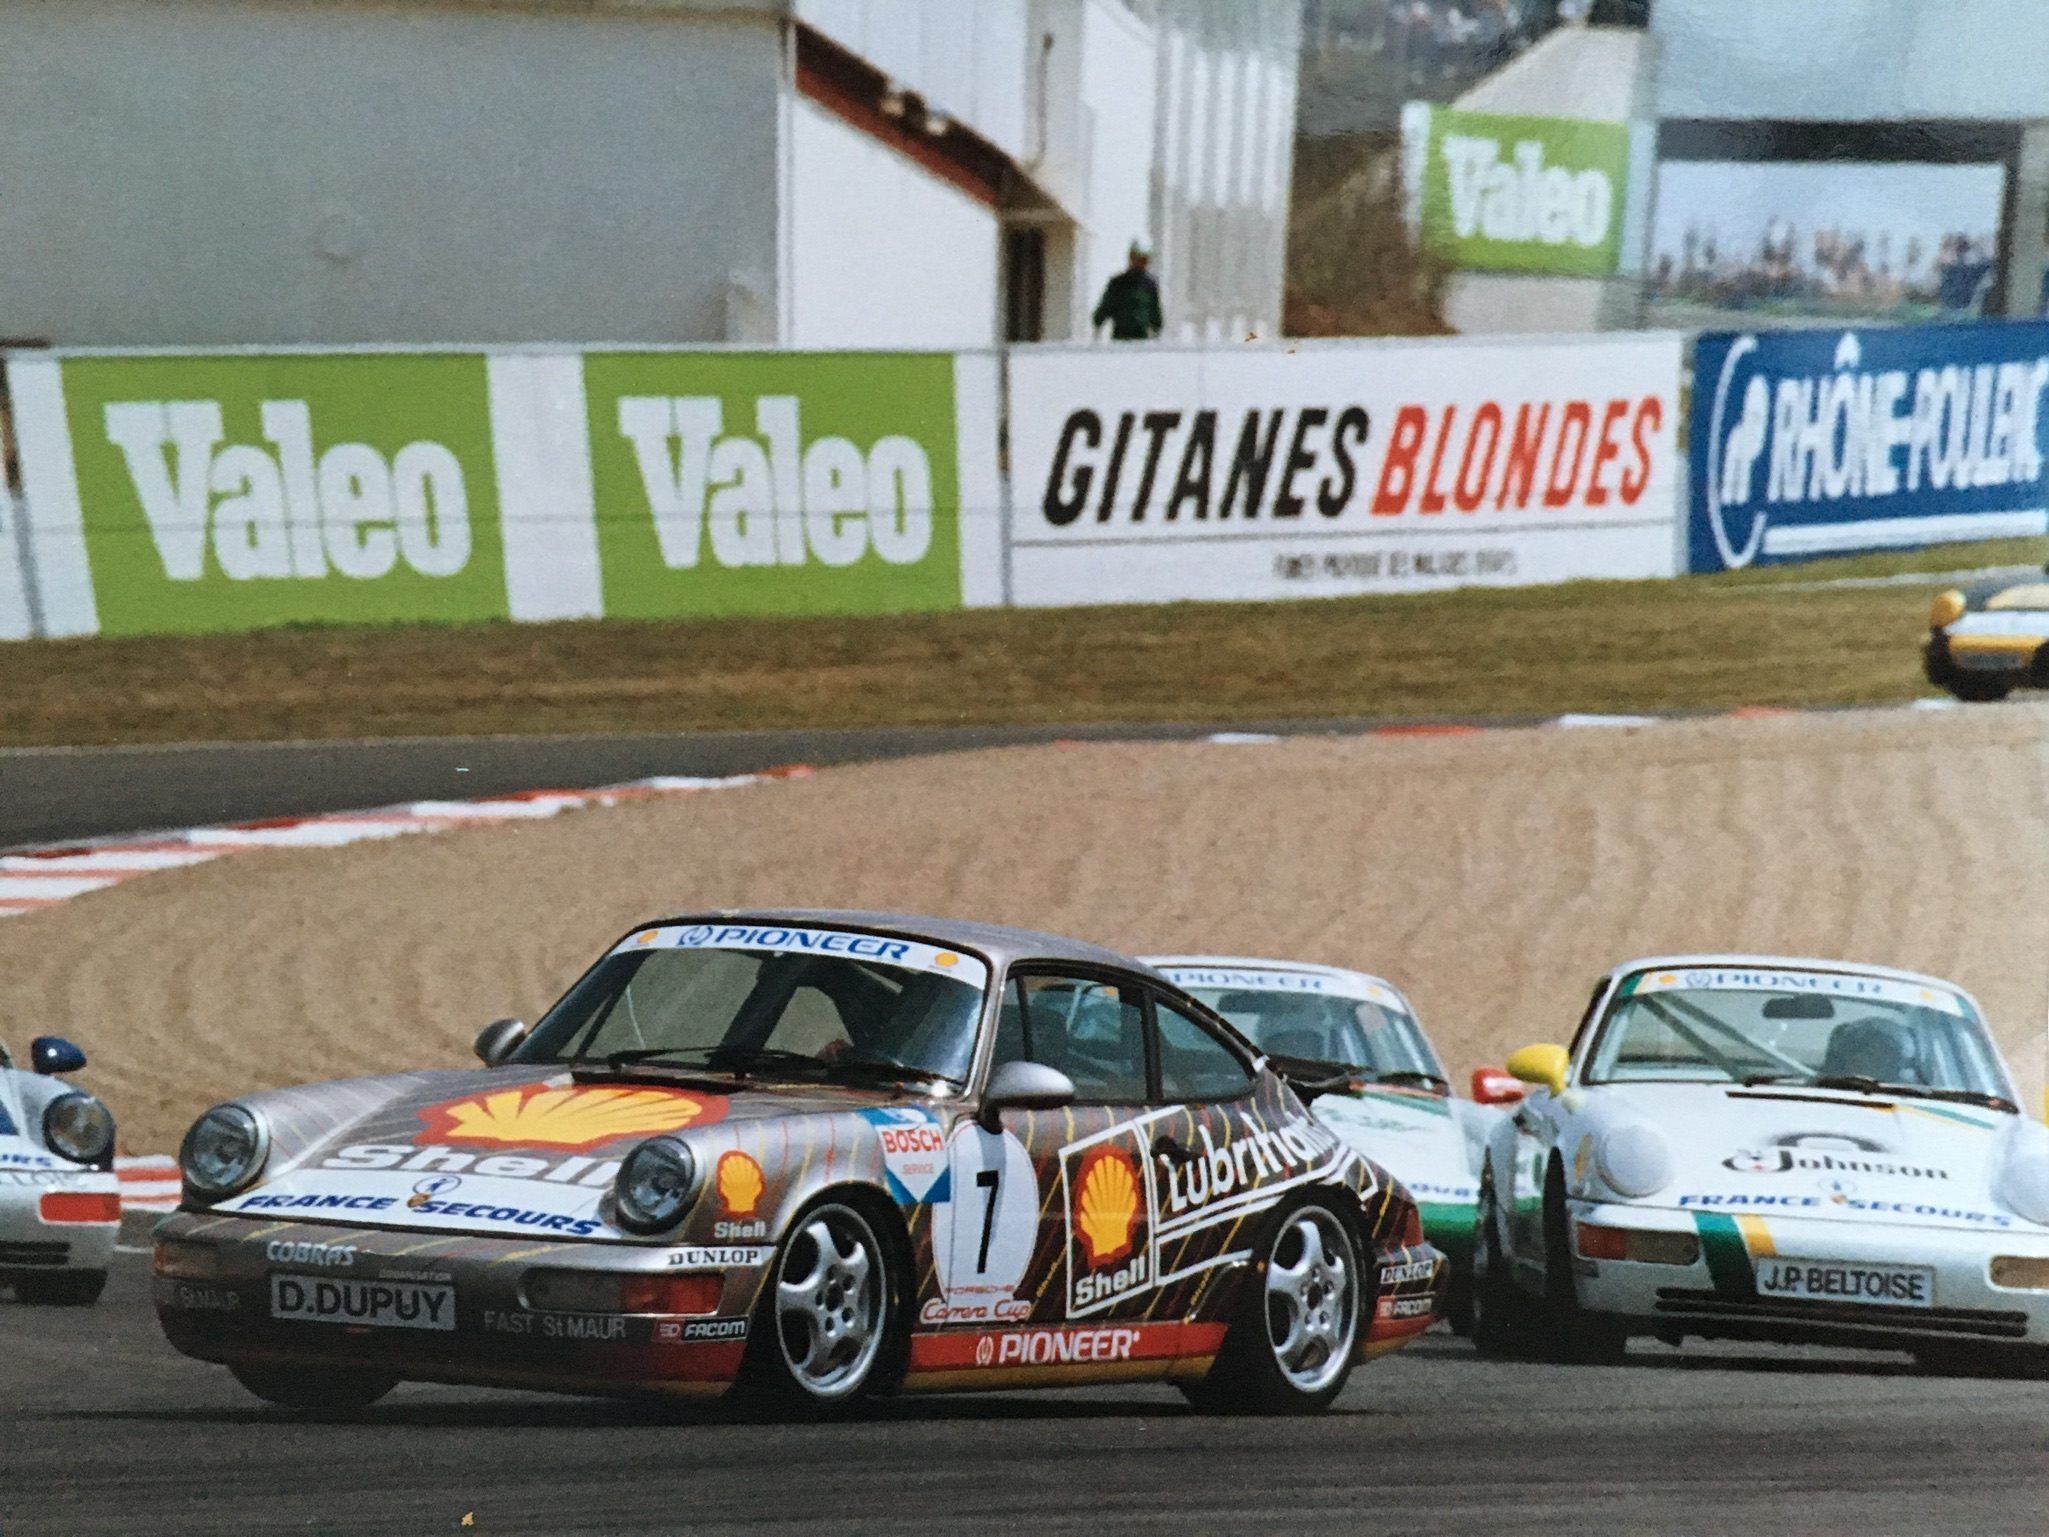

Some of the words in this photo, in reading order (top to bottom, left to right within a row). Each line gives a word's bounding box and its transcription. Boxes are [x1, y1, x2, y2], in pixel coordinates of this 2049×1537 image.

[1442, 136, 1611, 247] Valeo
[1043, 408, 1368, 525] GITANES
[1370, 396, 1663, 515] BLONDES
[104, 400, 472, 580] Valeo
[617, 395, 932, 568] Valeo
[715, 928, 909, 960] PIONEER
[882, 1130, 944, 1153] BOSCH
[323, 1144, 620, 1190] Shell
[1722, 1150, 1949, 1180] Johnson
[239, 1194, 399, 1211] FRANCE
[413, 1199, 604, 1236] SECOURS
[976, 1169, 999, 1274] 7
[1679, 1194, 1821, 1207] FRANCE
[1849, 1198, 2012, 1227] SECOURS
[714, 1220, 766, 1239] Shell
[266, 1240, 357, 1267] COBRAS
[668, 1249, 759, 1266] DUNLOP
[946, 1284, 1015, 1295] PORSCHE
[1075, 1255, 1146, 1306] Shell
[278, 1279, 447, 1323] D.DUPUY
[923, 1302, 988, 1321] Carrera
[994, 1298, 1031, 1321] Cup
[484, 1310, 533, 1333] FAST
[684, 1319, 746, 1338] FACOM
[998, 1328, 1134, 1364] PIONEER
